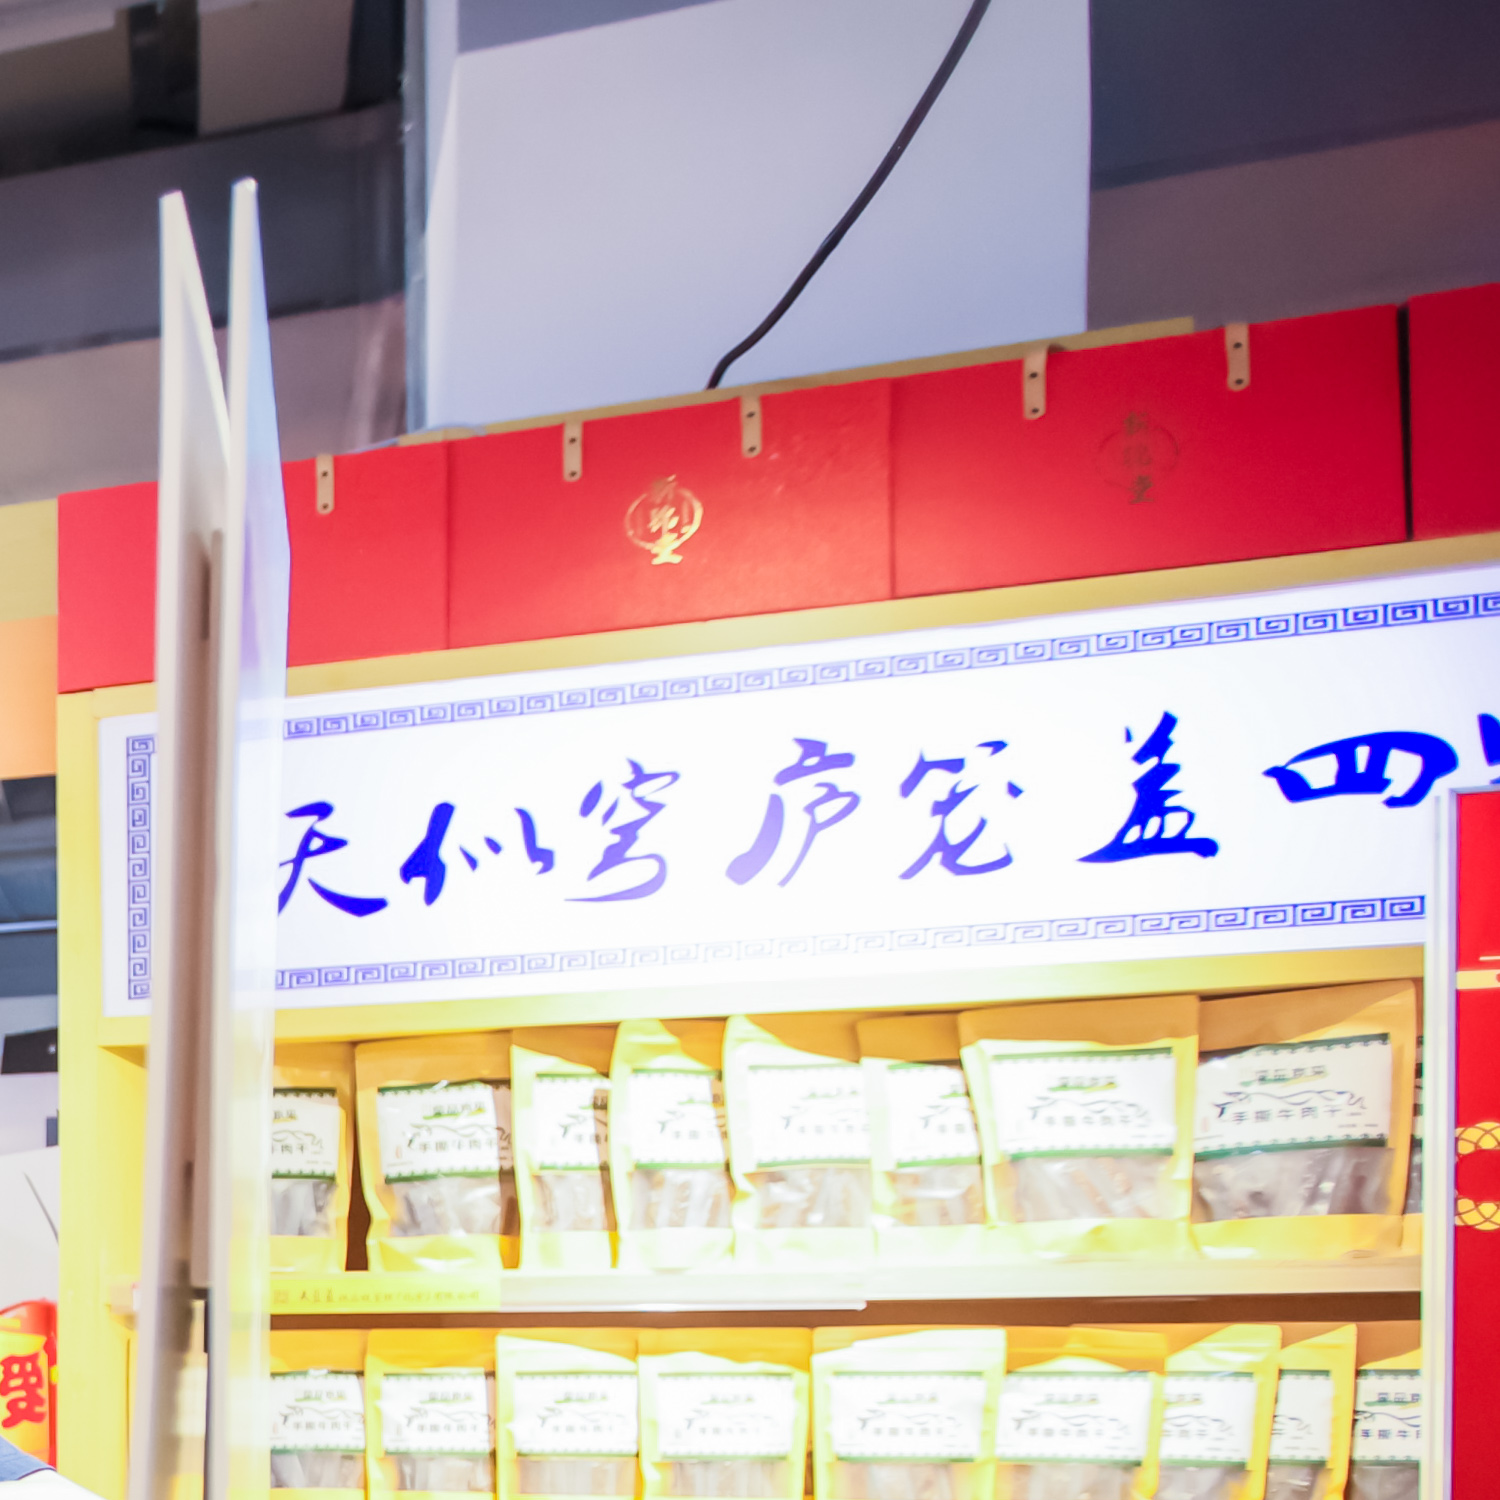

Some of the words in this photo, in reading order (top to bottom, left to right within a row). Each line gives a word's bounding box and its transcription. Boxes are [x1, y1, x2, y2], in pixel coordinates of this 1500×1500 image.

[278, 708, 1500, 917] 天似穹庐笼盖四
